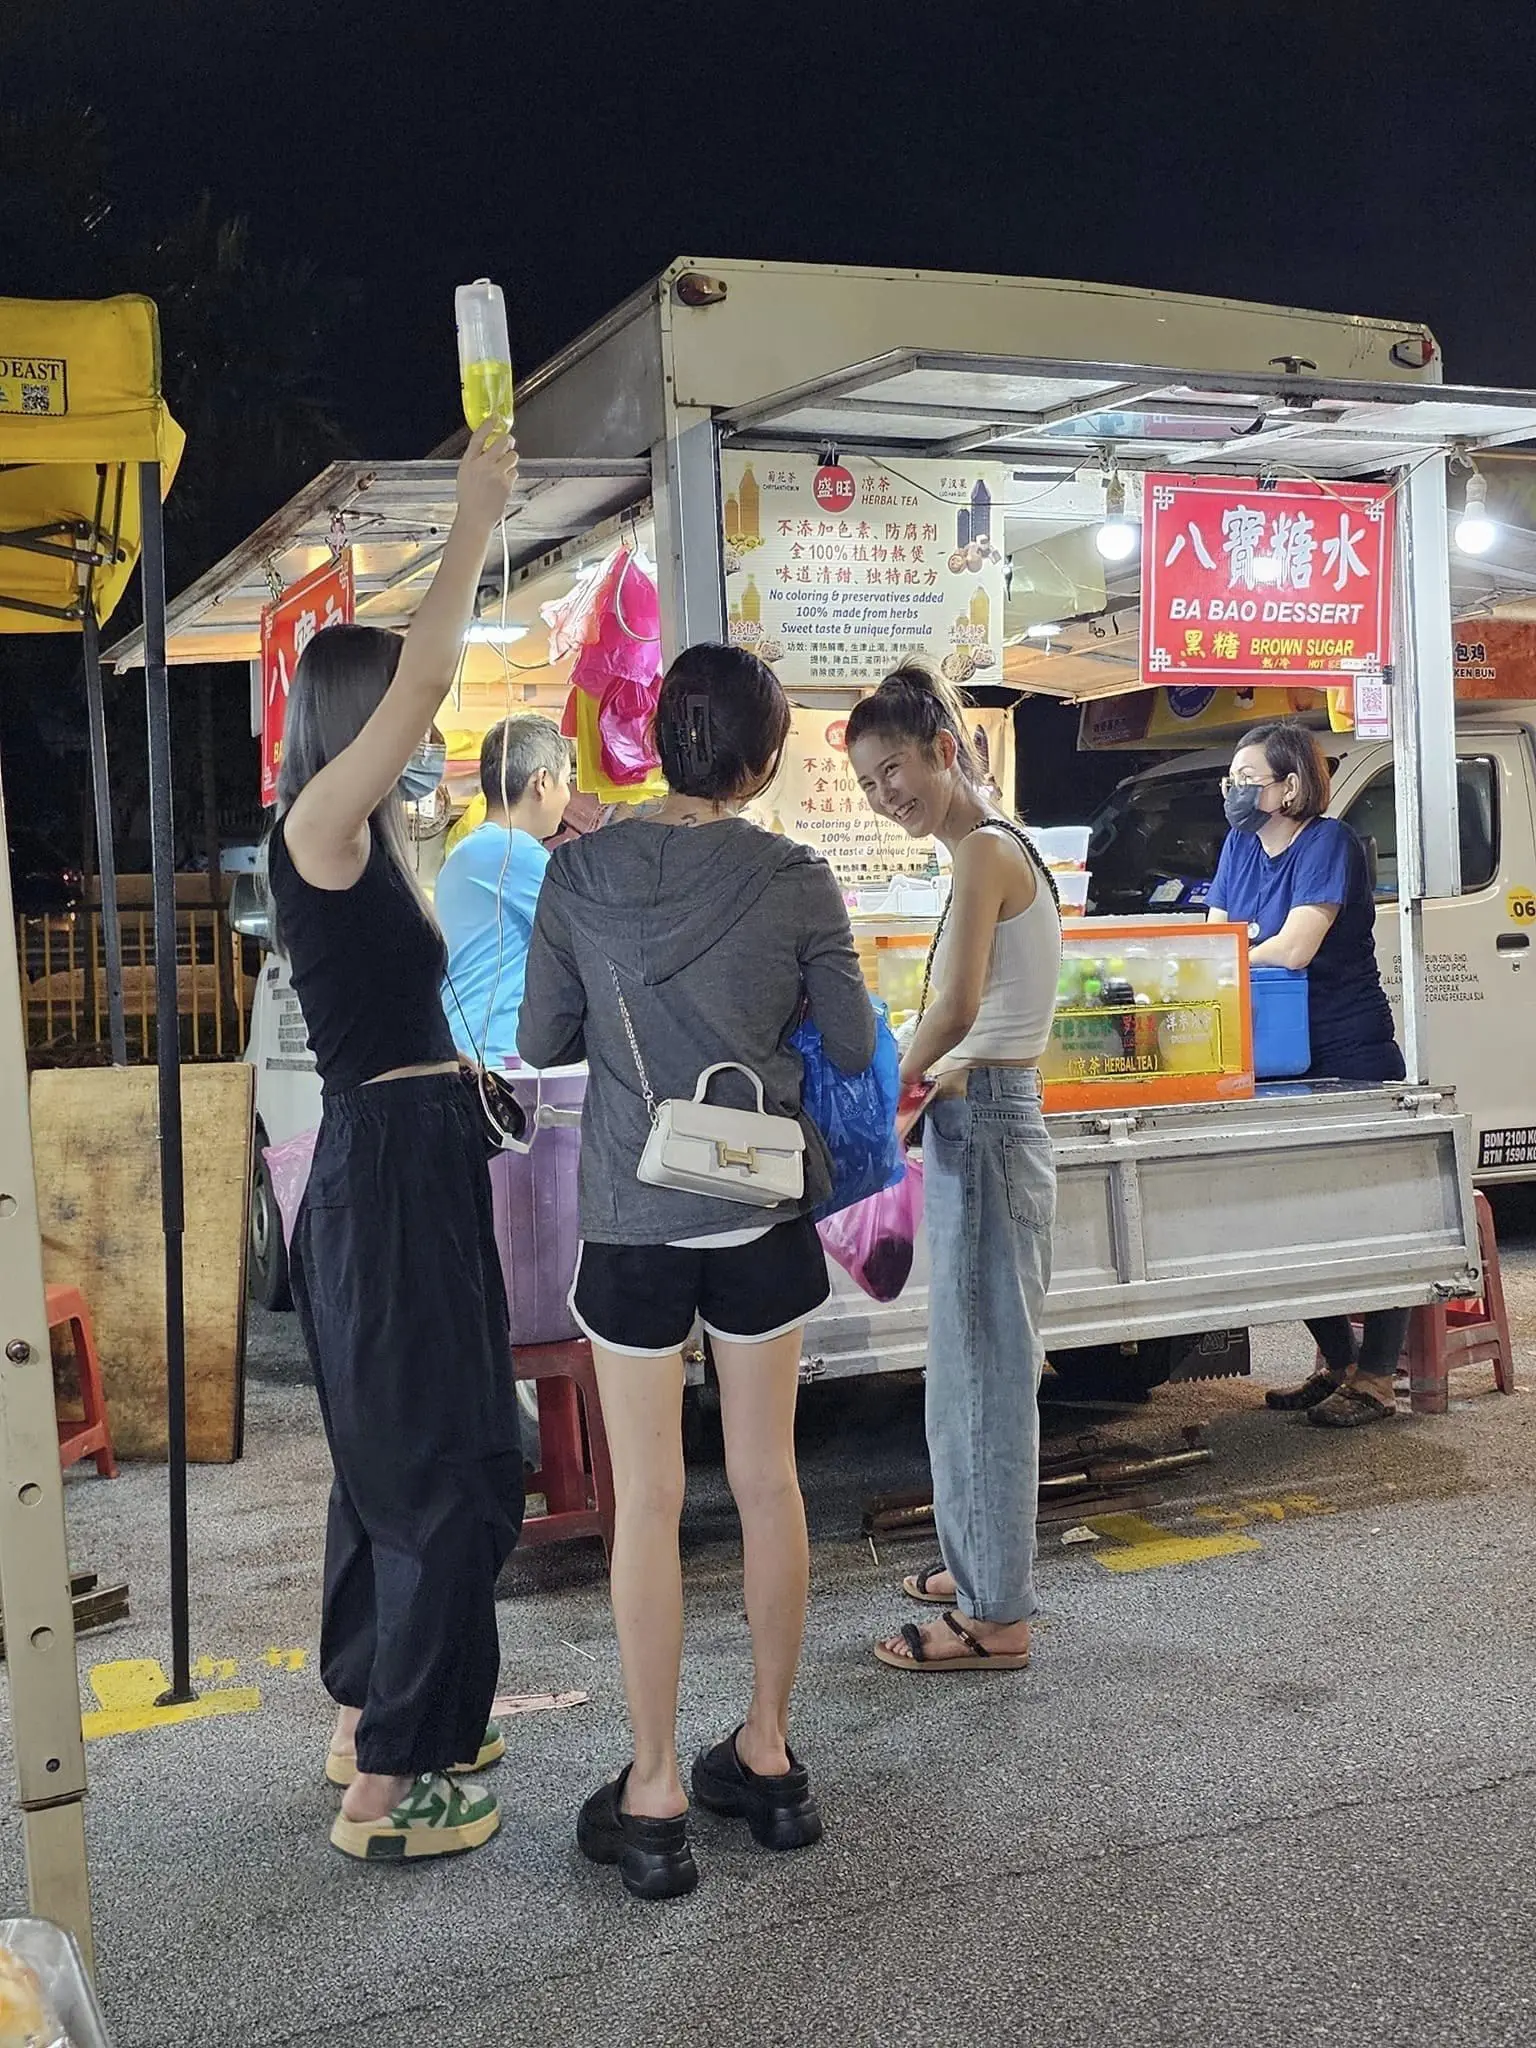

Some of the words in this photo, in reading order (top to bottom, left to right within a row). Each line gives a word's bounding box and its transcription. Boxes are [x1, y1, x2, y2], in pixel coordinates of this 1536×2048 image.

[817, 477, 852, 498] 盛旺
[861, 494, 898, 505] HERBAL
[901, 496, 918, 506] TEA
[777, 519, 937, 541] 不添加色素、防腐剂
[776, 565, 938, 586] 味道清甜、独特配方
[769, 589, 783, 600] No
[786, 590, 828, 604] coloring
[831, 590, 839, 601] &
[841, 591, 911, 605] preservatives
[912, 592, 944, 603] added
[796, 606, 828, 617] 100%
[832, 607, 861, 618] made
[861, 607, 888, 621] from
[890, 608, 918, 619] herbs
[1170, 598, 1202, 620] BA
[1208, 600, 1257, 622] BAO
[1262, 602, 1365, 625] DESSERT
[781, 622, 813, 634] Sweet
[815, 624, 841, 634] taste
[843, 623, 851, 634] &
[854, 625, 890, 637] unique
[889, 624, 932, 637] formula
[1180, 629, 1241, 660] 黑糖
[1250, 638, 1303, 657] BROWN
[1306, 639, 1356, 657] SUGAR
[1307, 660, 1324, 669] HOT
[1474, 668, 1495, 678] BUN
[796, 820, 808, 829] No
[811, 820, 850, 831] coloring
[854, 819, 861, 828] &
[820, 833, 851, 843] 100%
[855, 834, 881, 843] made
[883, 833, 903, 844] from
[839, 848, 863, 857] taste
[867, 847, 874, 856] &
[877, 848, 905, 859] unique
[1513, 901, 1536, 917] 06
[1104, 1056, 1135, 1072] HERBAL
[1505, 1130, 1527, 1147] 2100
[1505, 1147, 1526, 1162] 1590
